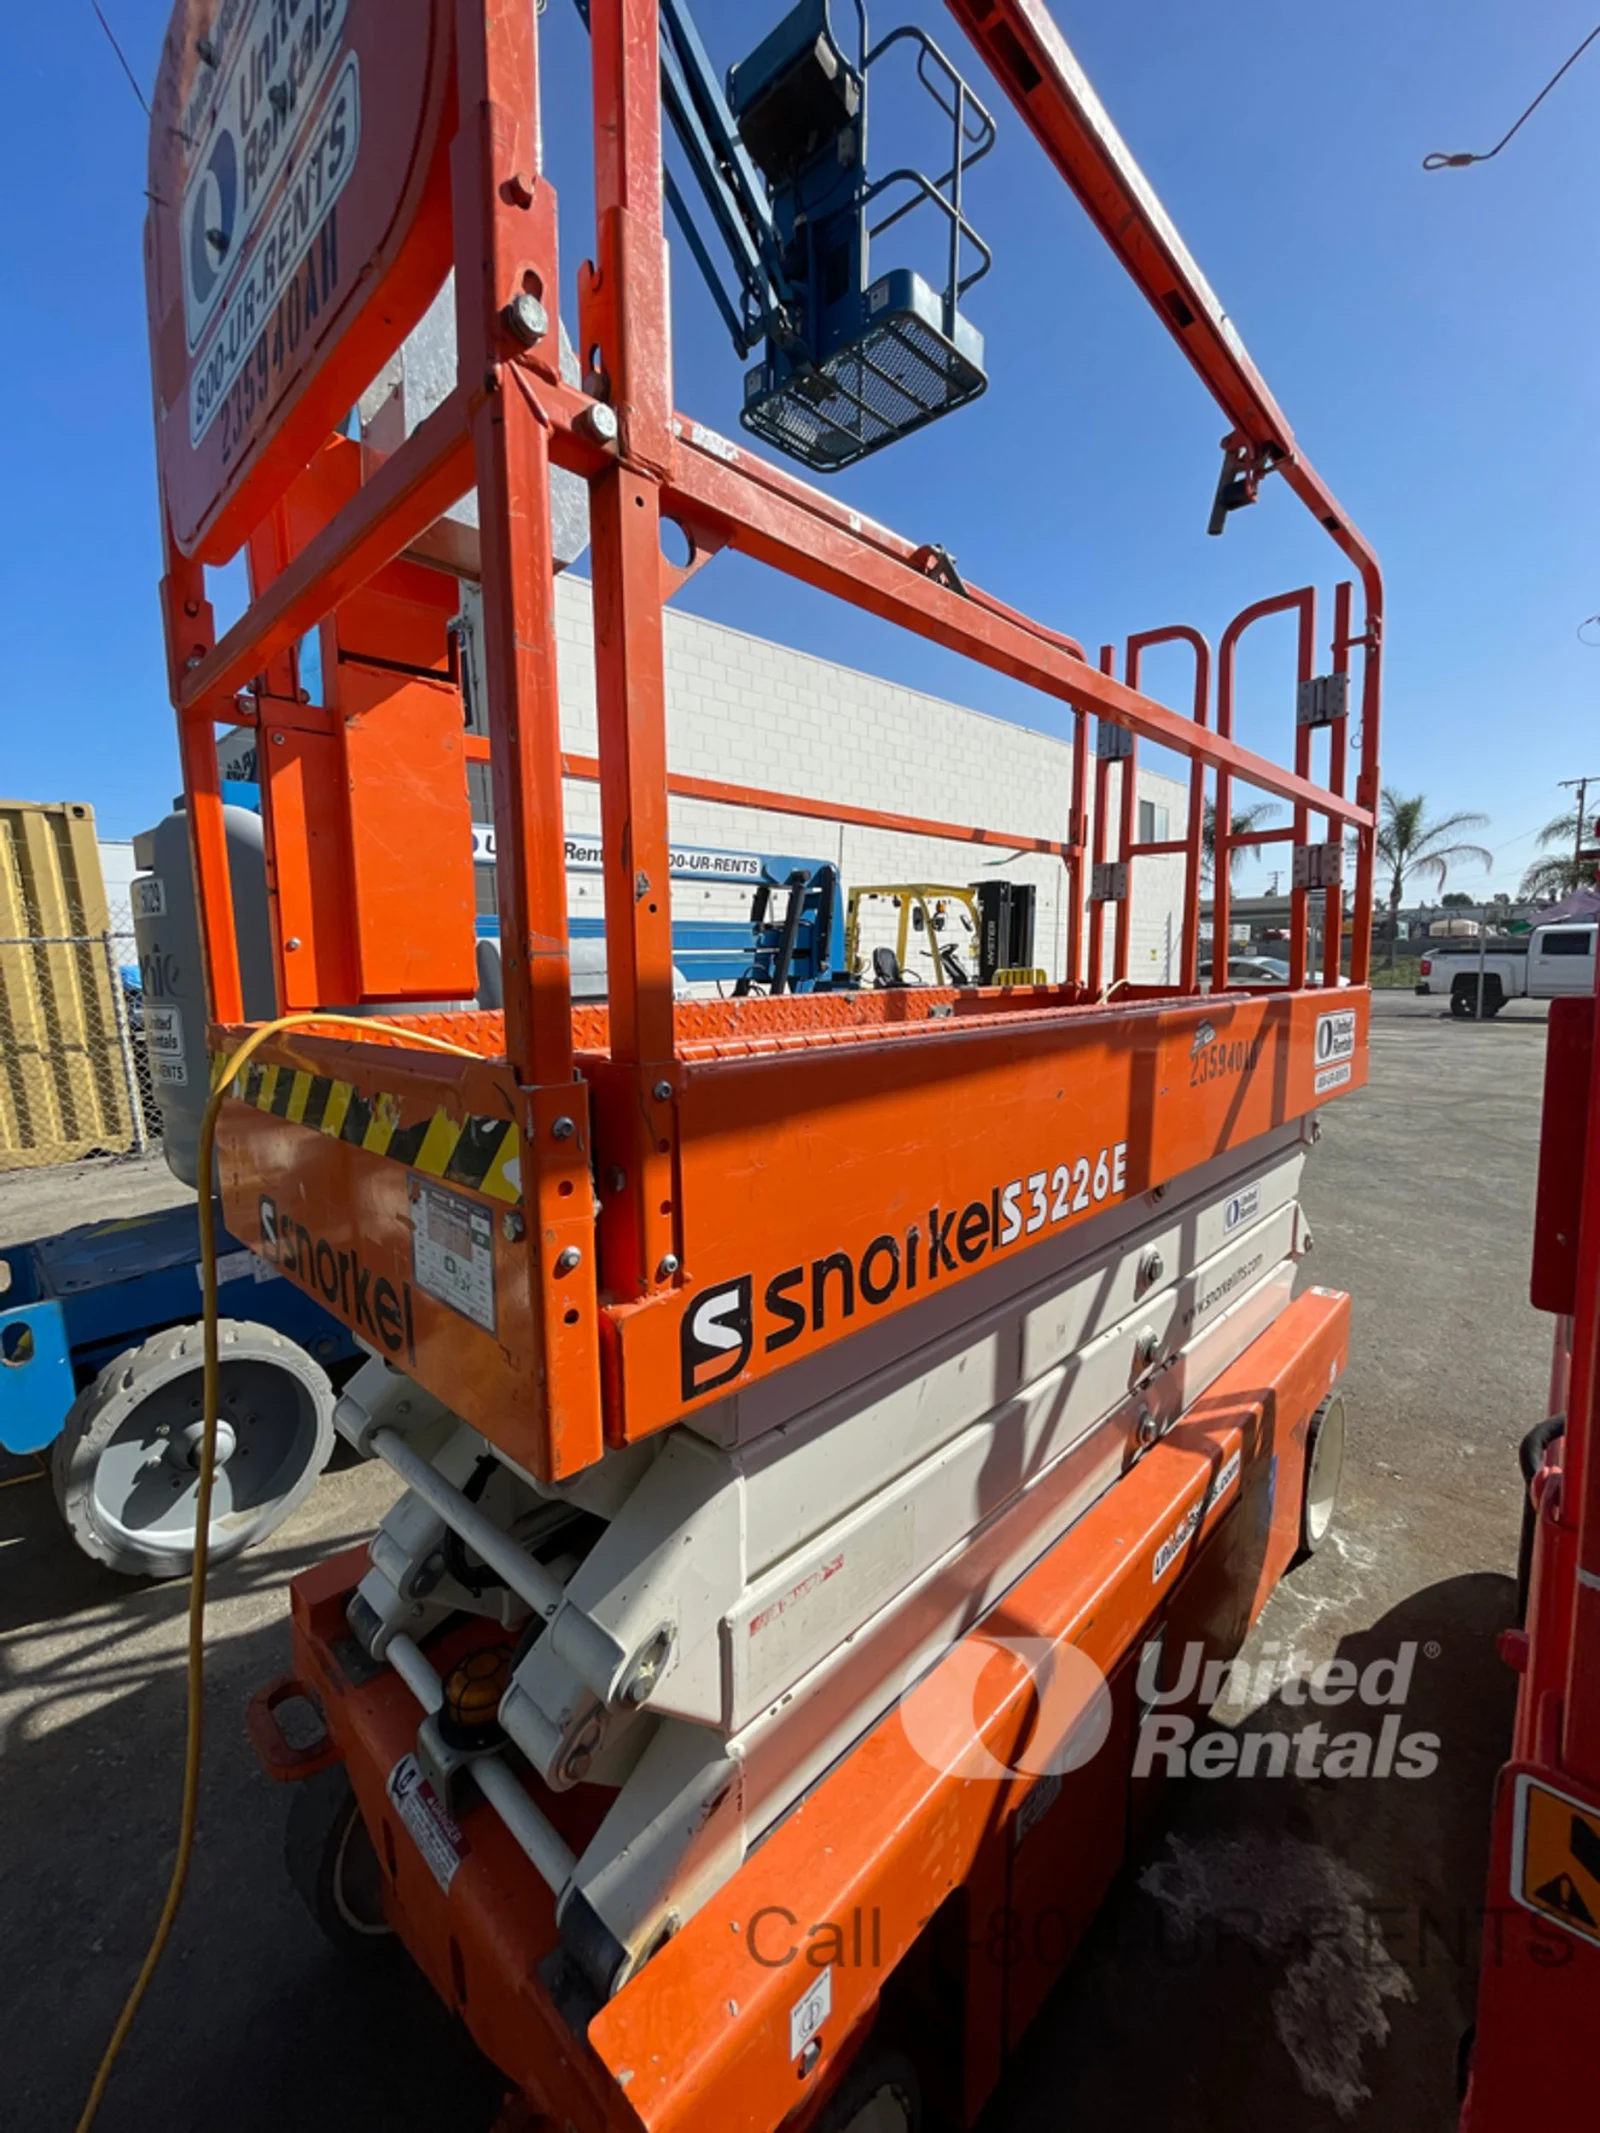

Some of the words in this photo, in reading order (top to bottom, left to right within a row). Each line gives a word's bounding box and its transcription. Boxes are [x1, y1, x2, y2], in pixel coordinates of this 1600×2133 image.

[240, 0, 300, 137] Unit
[281, 1214, 417, 1367] snorkel
[765, 1187, 1001, 1354] snorkel
[999, 1141, 1128, 1246] S3226E
